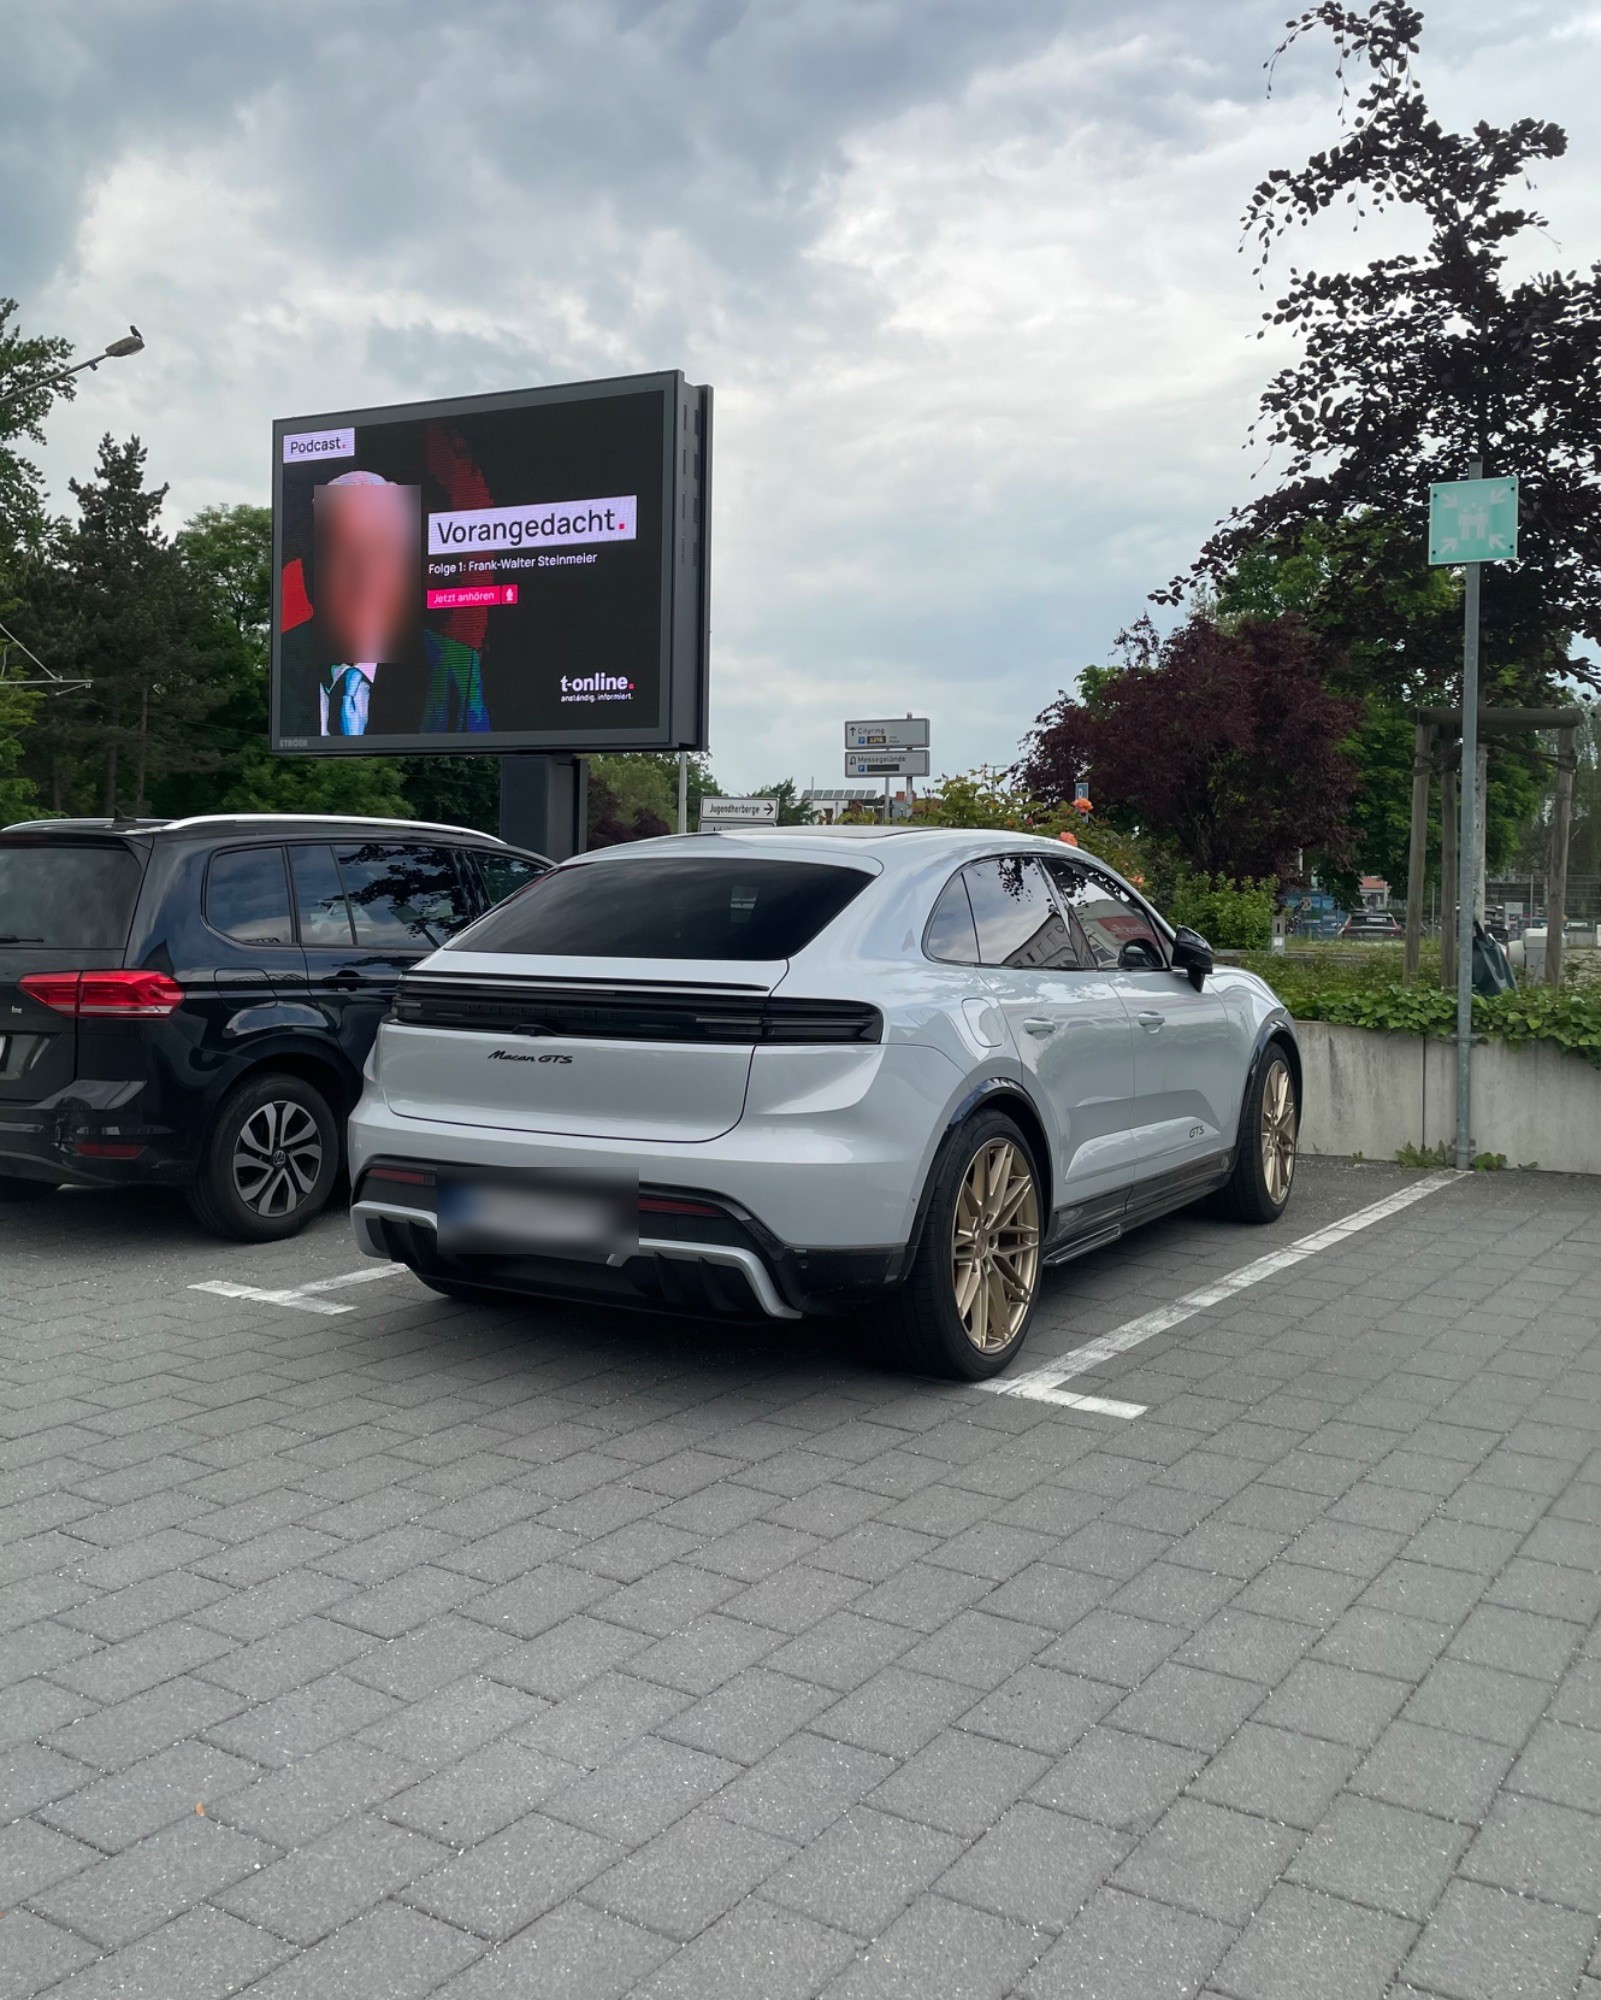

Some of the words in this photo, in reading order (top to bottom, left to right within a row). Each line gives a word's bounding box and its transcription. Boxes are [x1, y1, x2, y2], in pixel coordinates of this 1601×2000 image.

[291, 437, 346, 454] Podcast.
[437, 508, 626, 546] Vorangedacht.
[428, 563, 457, 577] Folge
[458, 561, 467, 573] 1:
[468, 557, 536, 572] Frank-Walter
[537, 552, 598, 567] Steinmeier
[433, 594, 456, 604] Jetzt
[457, 591, 495, 602] anhören
[857, 728, 885, 736] Cityring
[857, 755, 906, 764] Messegelände
[709, 803, 760, 816] Jugendherberge
[487, 1049, 535, 1062] Macan
[538, 1054, 573, 1064] GTS
[1188, 1124, 1205, 1138] GTS
